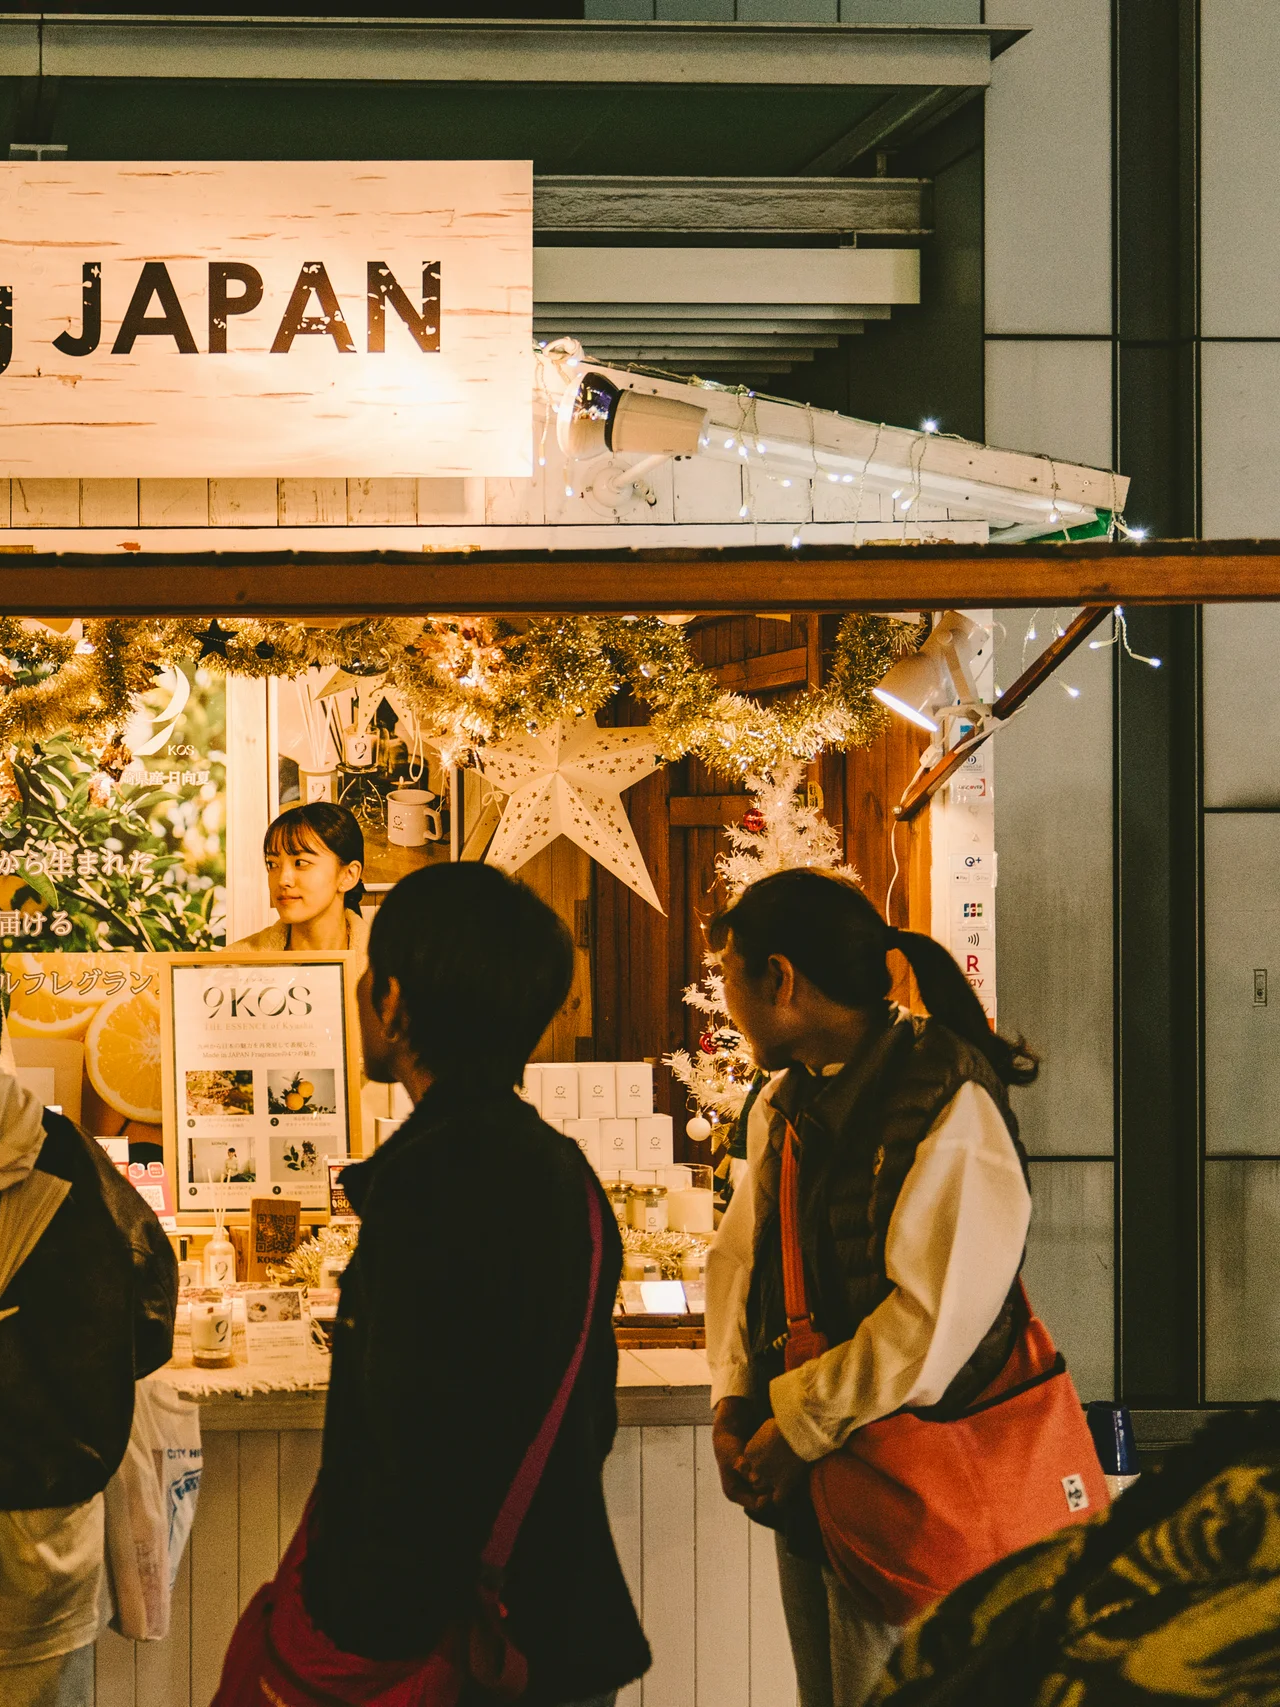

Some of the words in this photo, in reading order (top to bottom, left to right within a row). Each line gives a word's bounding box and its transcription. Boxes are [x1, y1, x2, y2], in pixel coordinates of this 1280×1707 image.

[51, 260, 442, 356] JAPAN
[167, 744, 195, 756] KOS
[168, 769, 211, 786] 日向夏
[0, 968, 160, 996] ルフレグラン
[967, 978, 985, 988] ay
[203, 986, 313, 1019] 9KOS
[225, 1022, 268, 1031] ESSENCE
[215, 1261, 228, 1281] 9
[215, 1320, 228, 1343] 9
